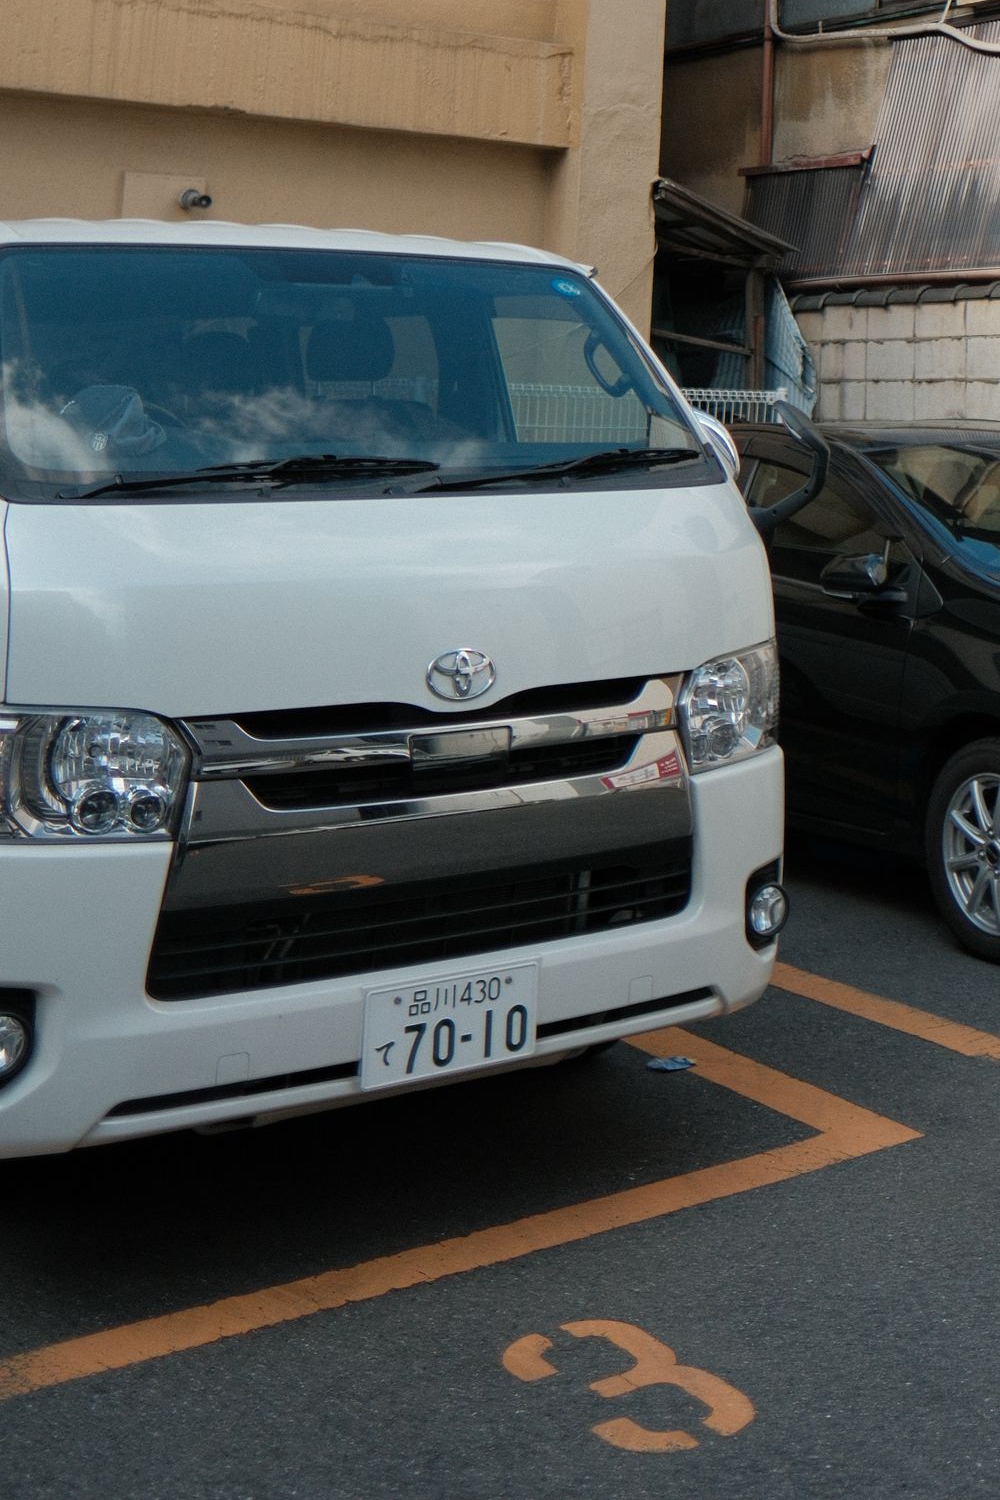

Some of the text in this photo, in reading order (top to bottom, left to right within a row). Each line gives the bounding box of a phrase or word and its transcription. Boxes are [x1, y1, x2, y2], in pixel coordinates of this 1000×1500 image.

[375, 1004, 528, 1075] て 70-10
[502, 1318, 757, 1453] 3
